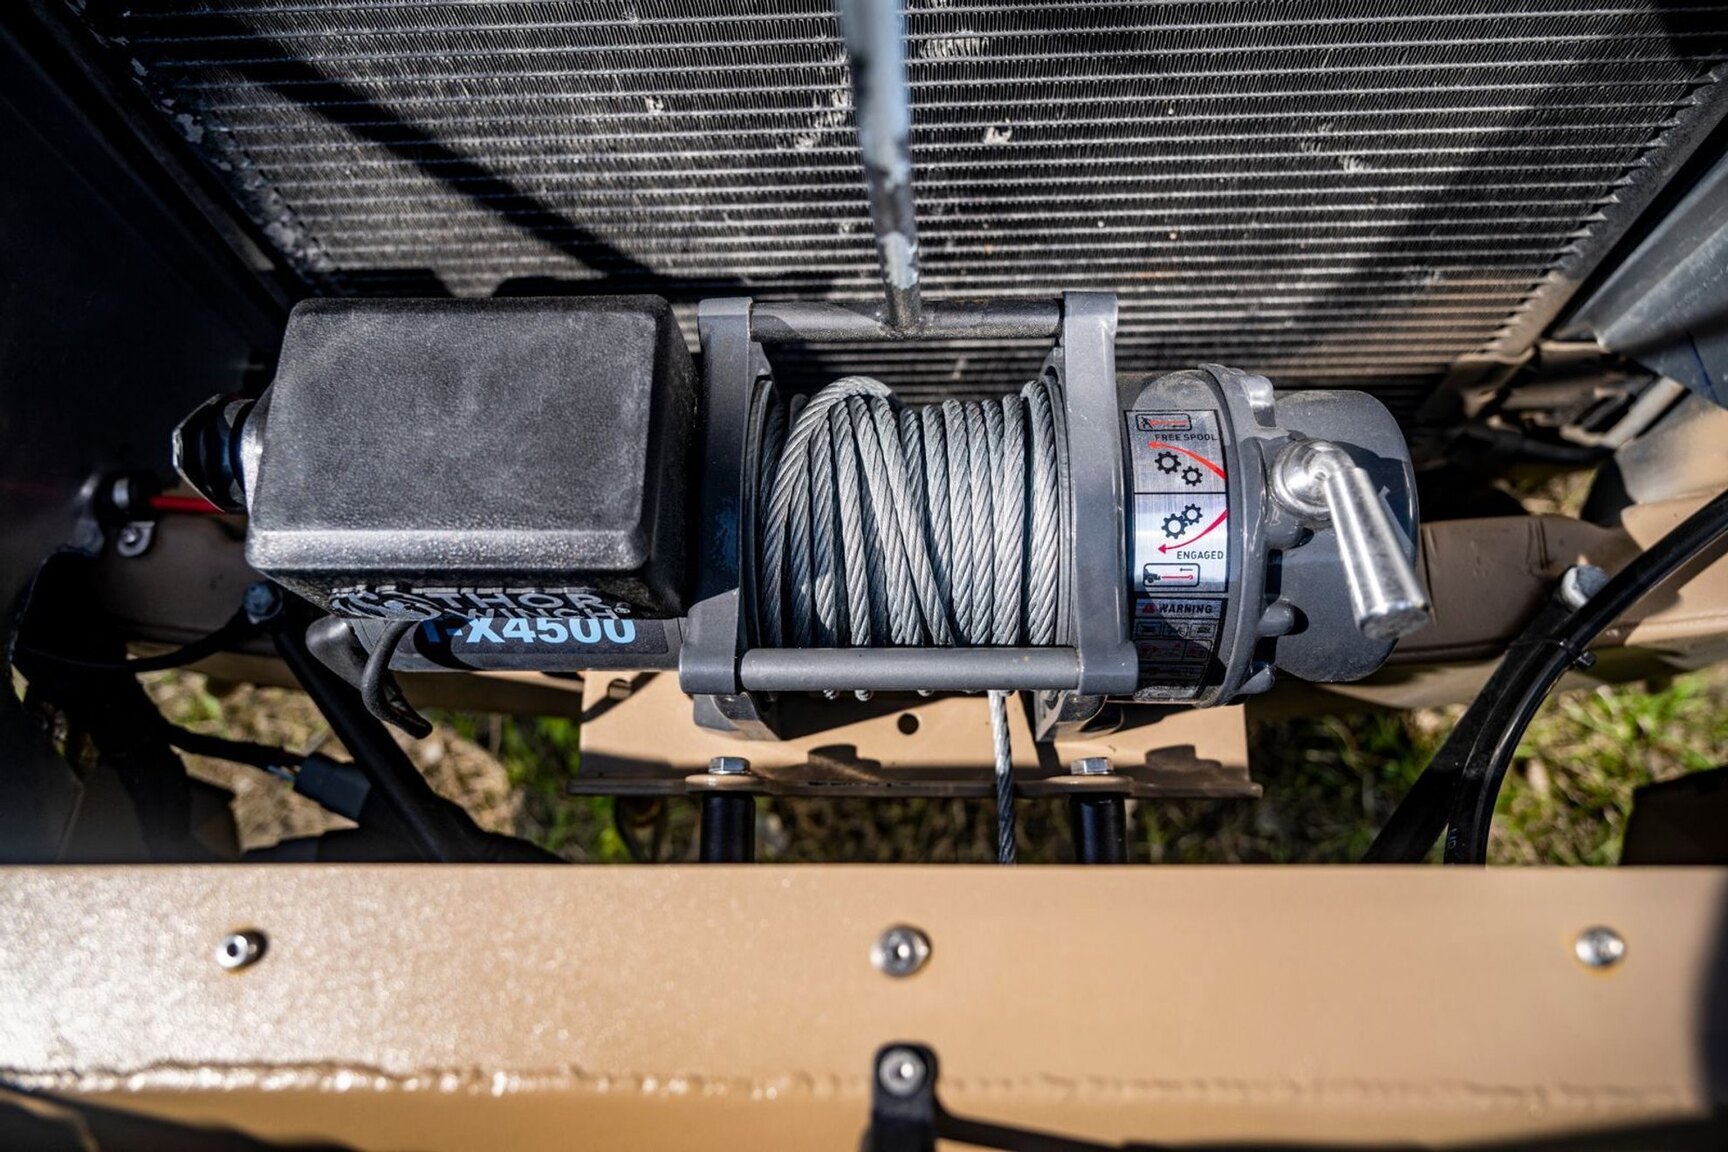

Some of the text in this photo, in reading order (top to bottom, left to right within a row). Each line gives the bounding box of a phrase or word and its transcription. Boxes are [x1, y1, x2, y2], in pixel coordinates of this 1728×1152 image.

[1154, 433, 1217, 441] FREE SPOOL
[1176, 550, 1224, 560] ENGAGED
[424, 592, 612, 609] THOR
[443, 607, 620, 620] WINCH
[1159, 603, 1213, 614] WARNING
